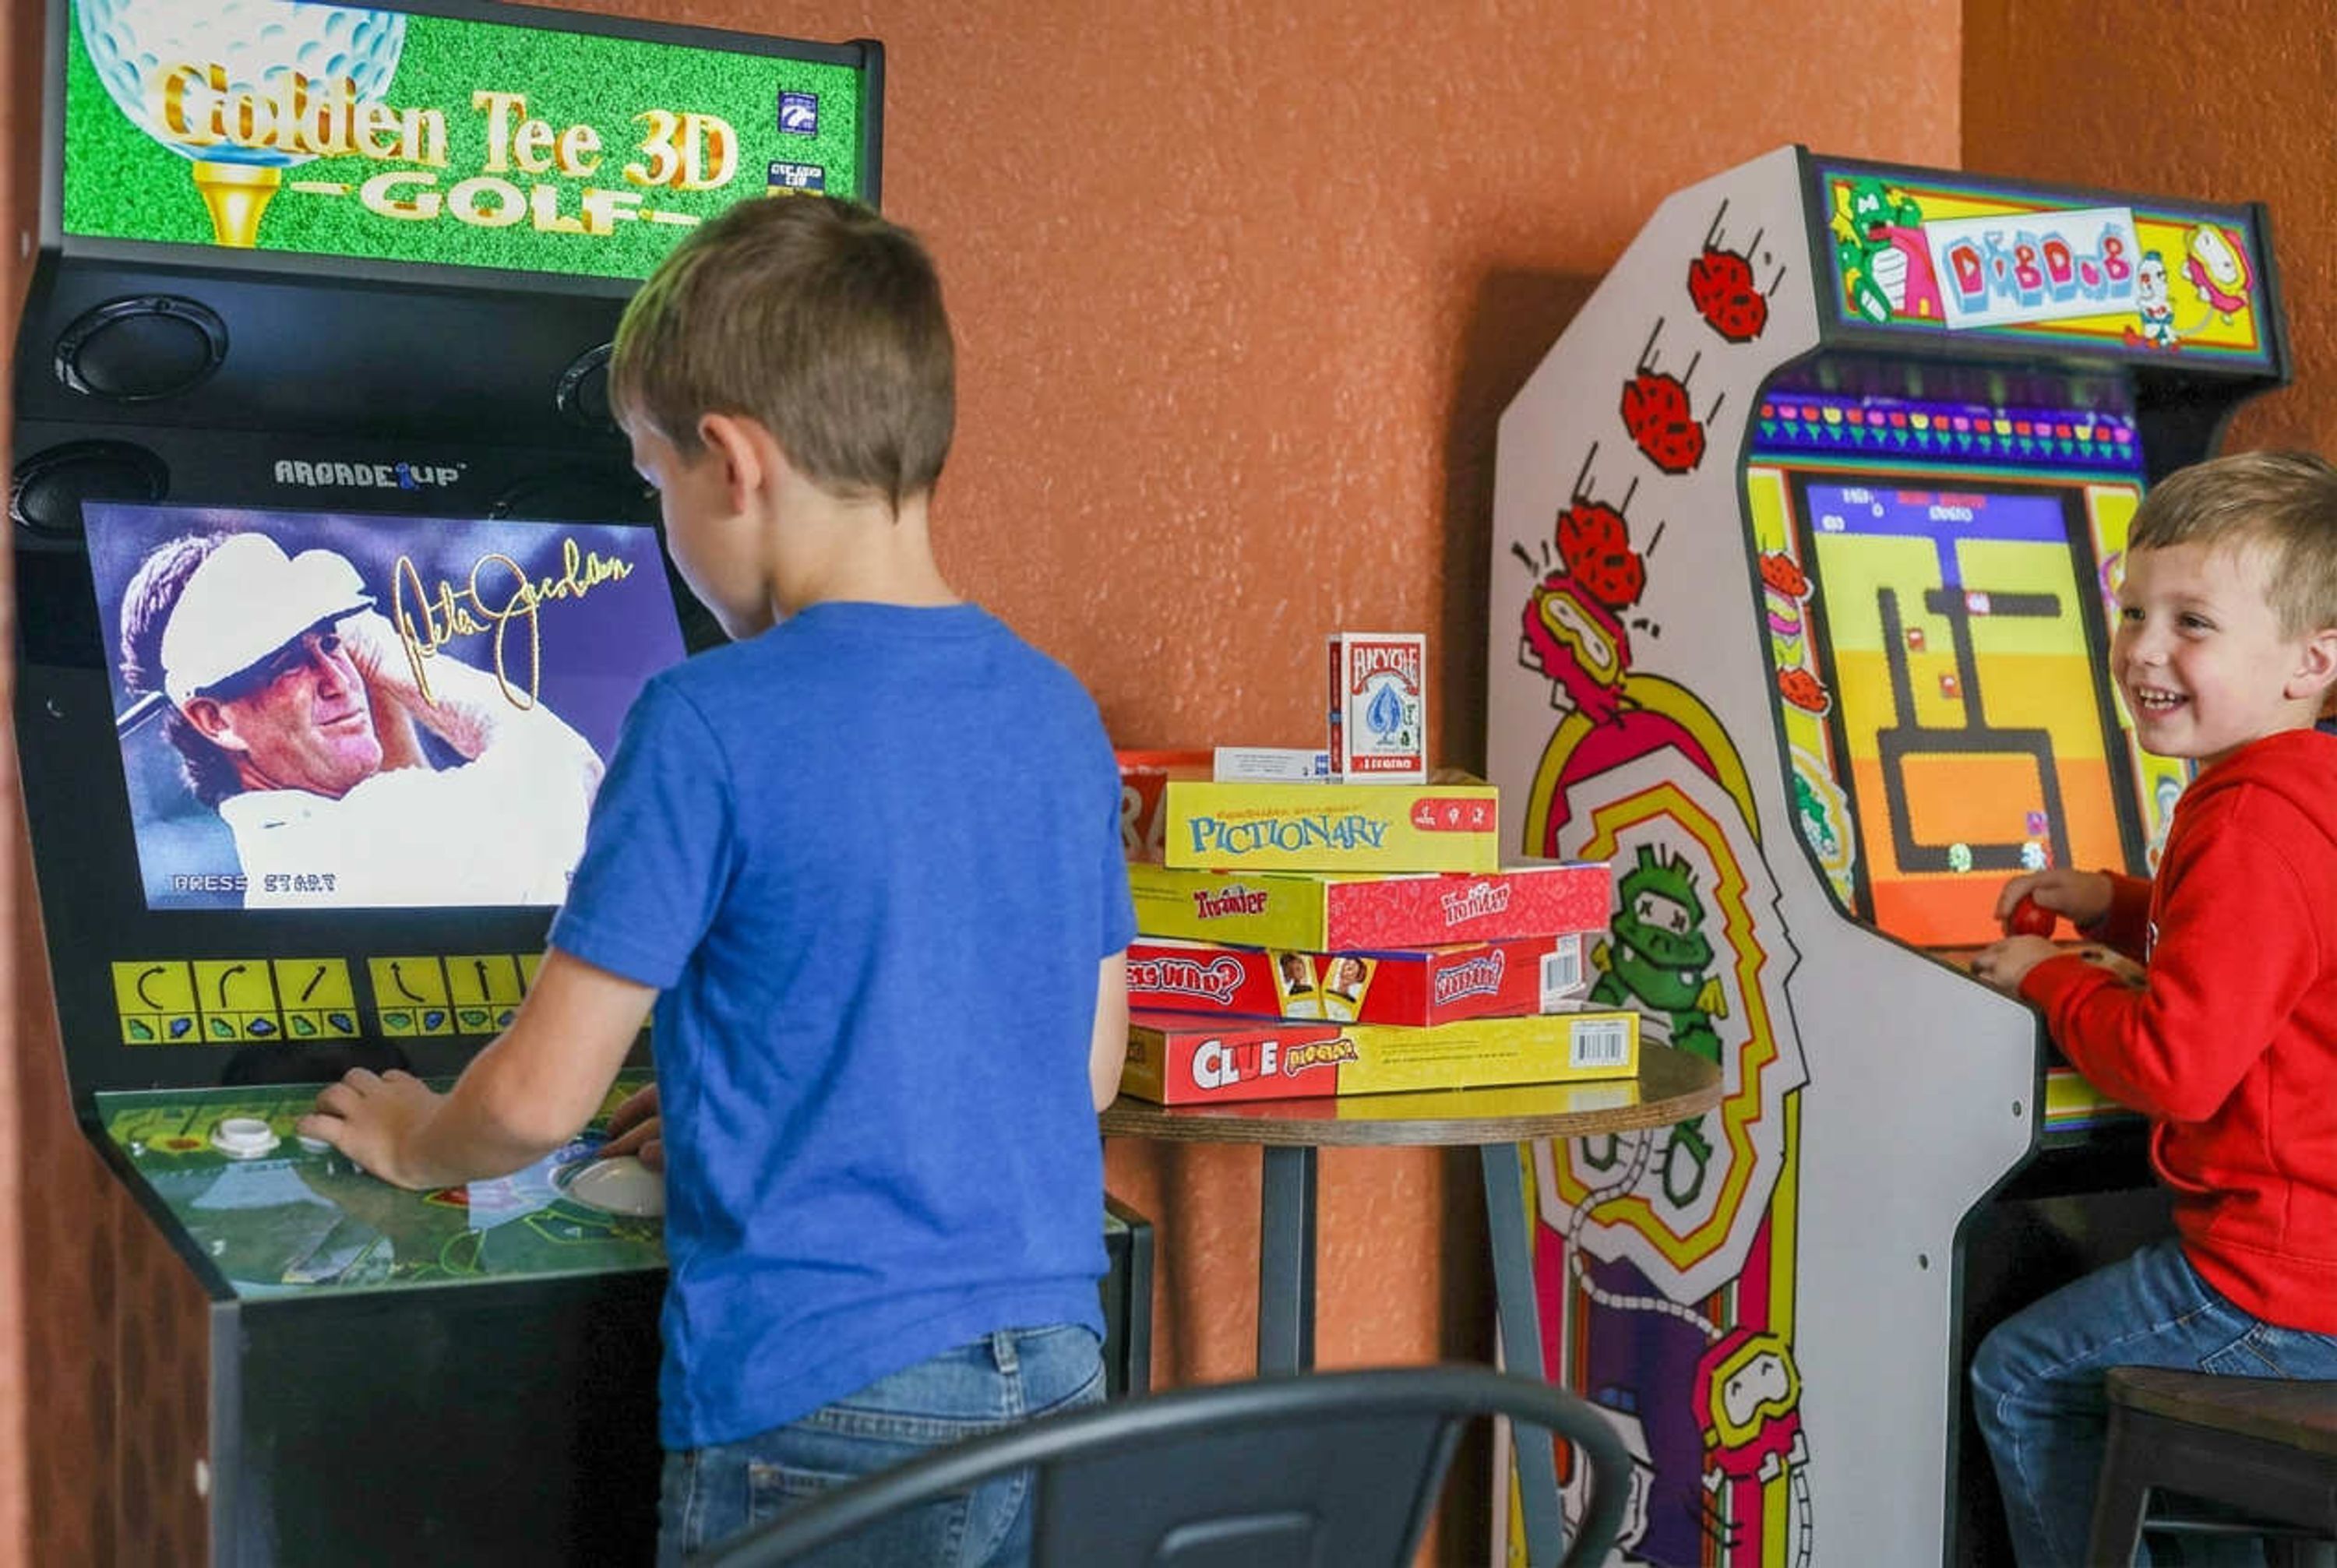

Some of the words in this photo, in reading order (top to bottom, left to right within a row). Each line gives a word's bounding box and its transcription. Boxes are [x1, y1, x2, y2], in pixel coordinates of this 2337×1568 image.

[164, 62, 448, 167] Golden
[471, 88, 603, 178] Tee
[622, 108, 738, 192] 3D
[359, 170, 643, 236] GOLF
[1189, 814, 1388, 854] PICTIONARY
[174, 874, 249, 892] PRESS
[263, 873, 337, 893] START
[1192, 1037, 1280, 1089] CLUE
